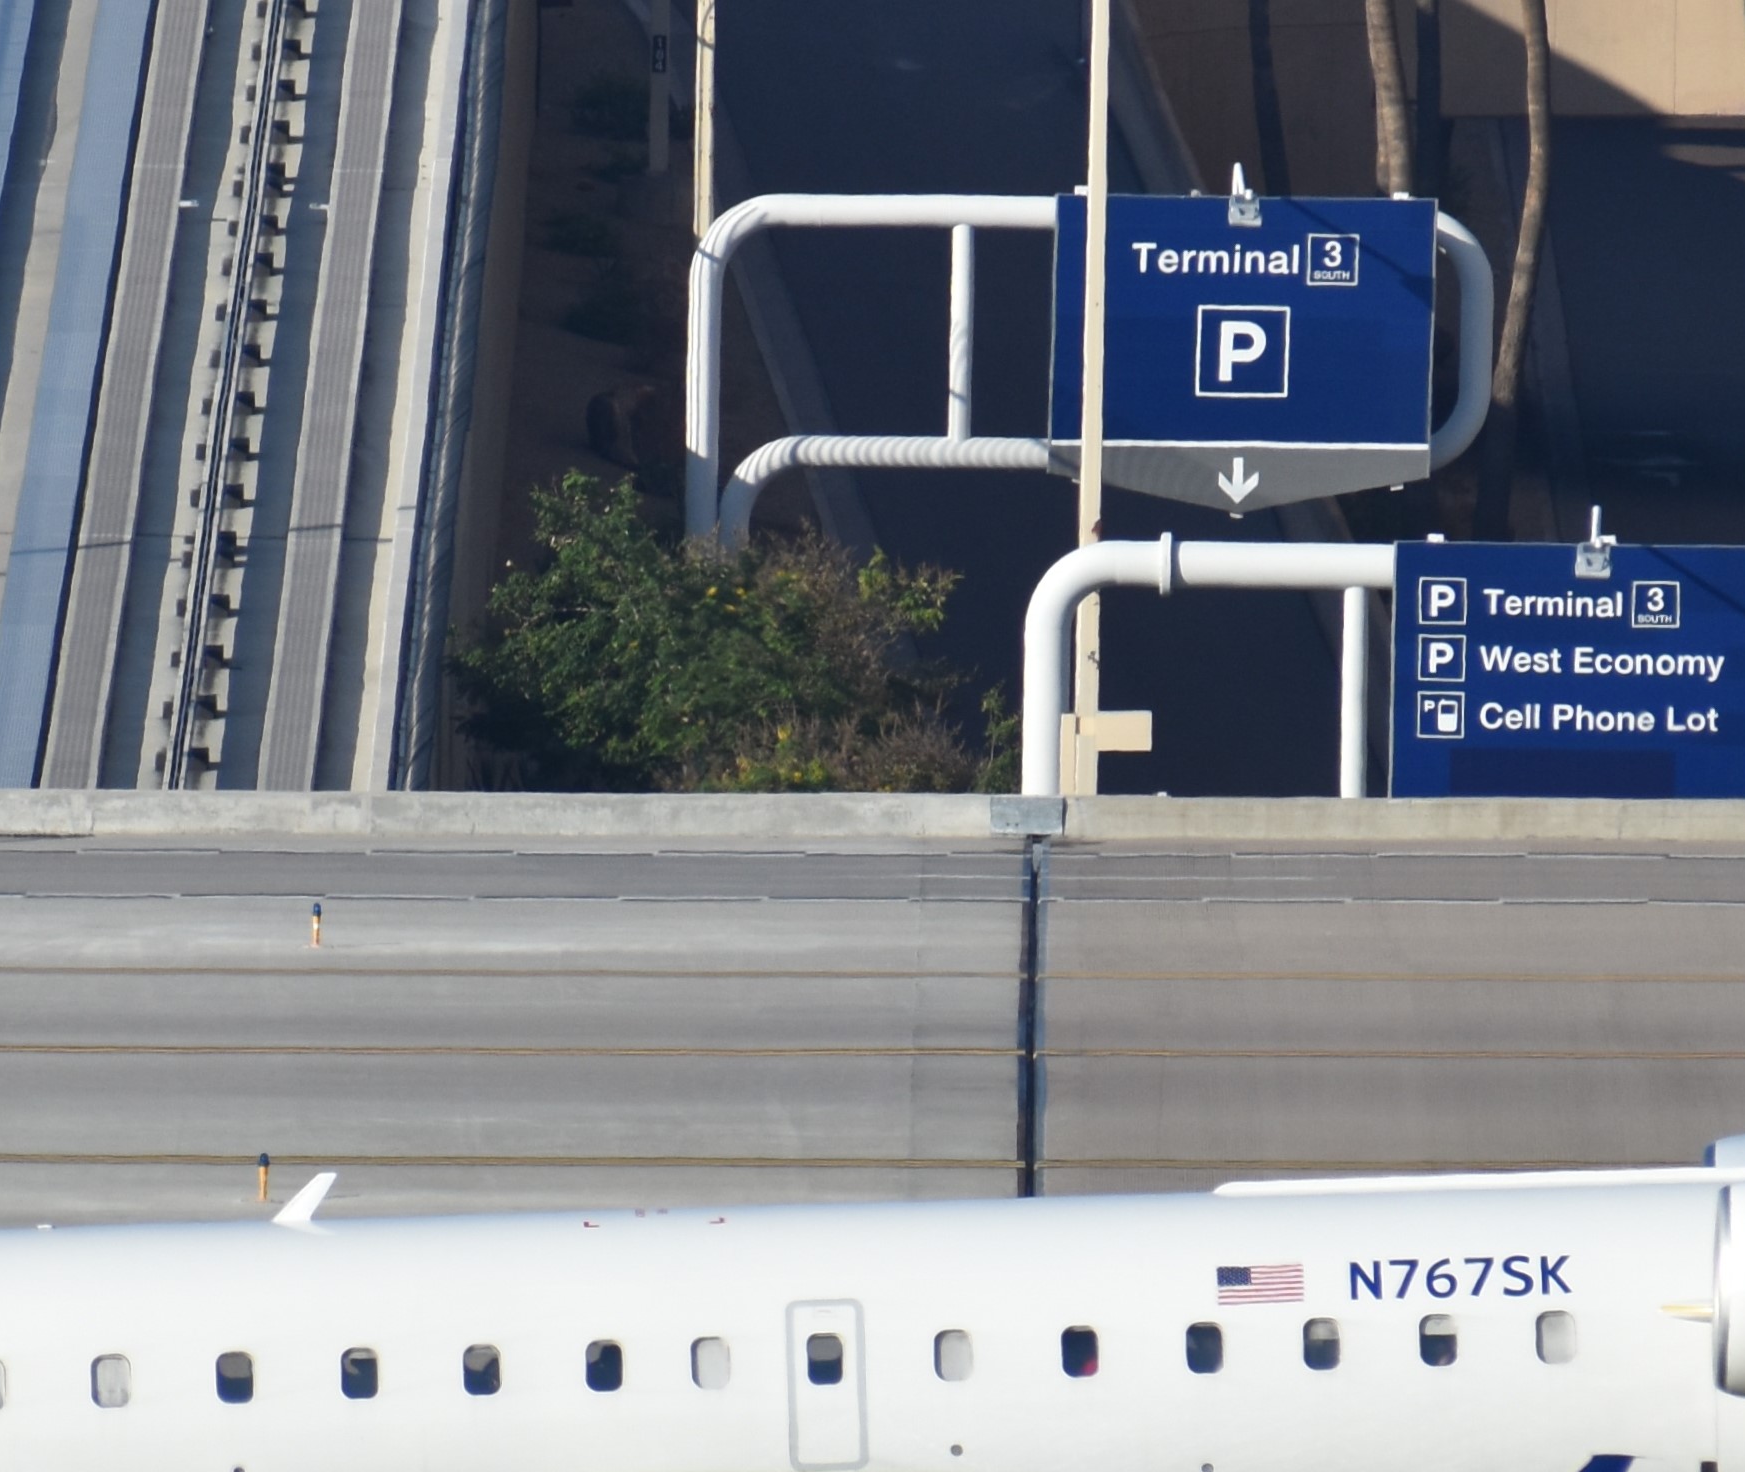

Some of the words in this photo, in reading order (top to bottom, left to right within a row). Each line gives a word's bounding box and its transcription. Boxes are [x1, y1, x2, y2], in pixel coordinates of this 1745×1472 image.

[1132, 242, 1299, 274] Terminal
[1324, 241, 1342, 267] 3
[1313, 270, 1351, 280] SOUTH
[1218, 320, 1266, 382] P
[1483, 588, 1623, 617] Terminal
[1647, 587, 1665, 612] 3
[1637, 614, 1673, 624] SOUTH
[1480, 645, 1562, 673] West
[1574, 647, 1725, 682] Economy
[1479, 703, 1541, 730] Cell
[1553, 704, 1655, 732] Phone
[1667, 706, 1719, 732] Lot
[1349, 1255, 1573, 1300] N767SK
